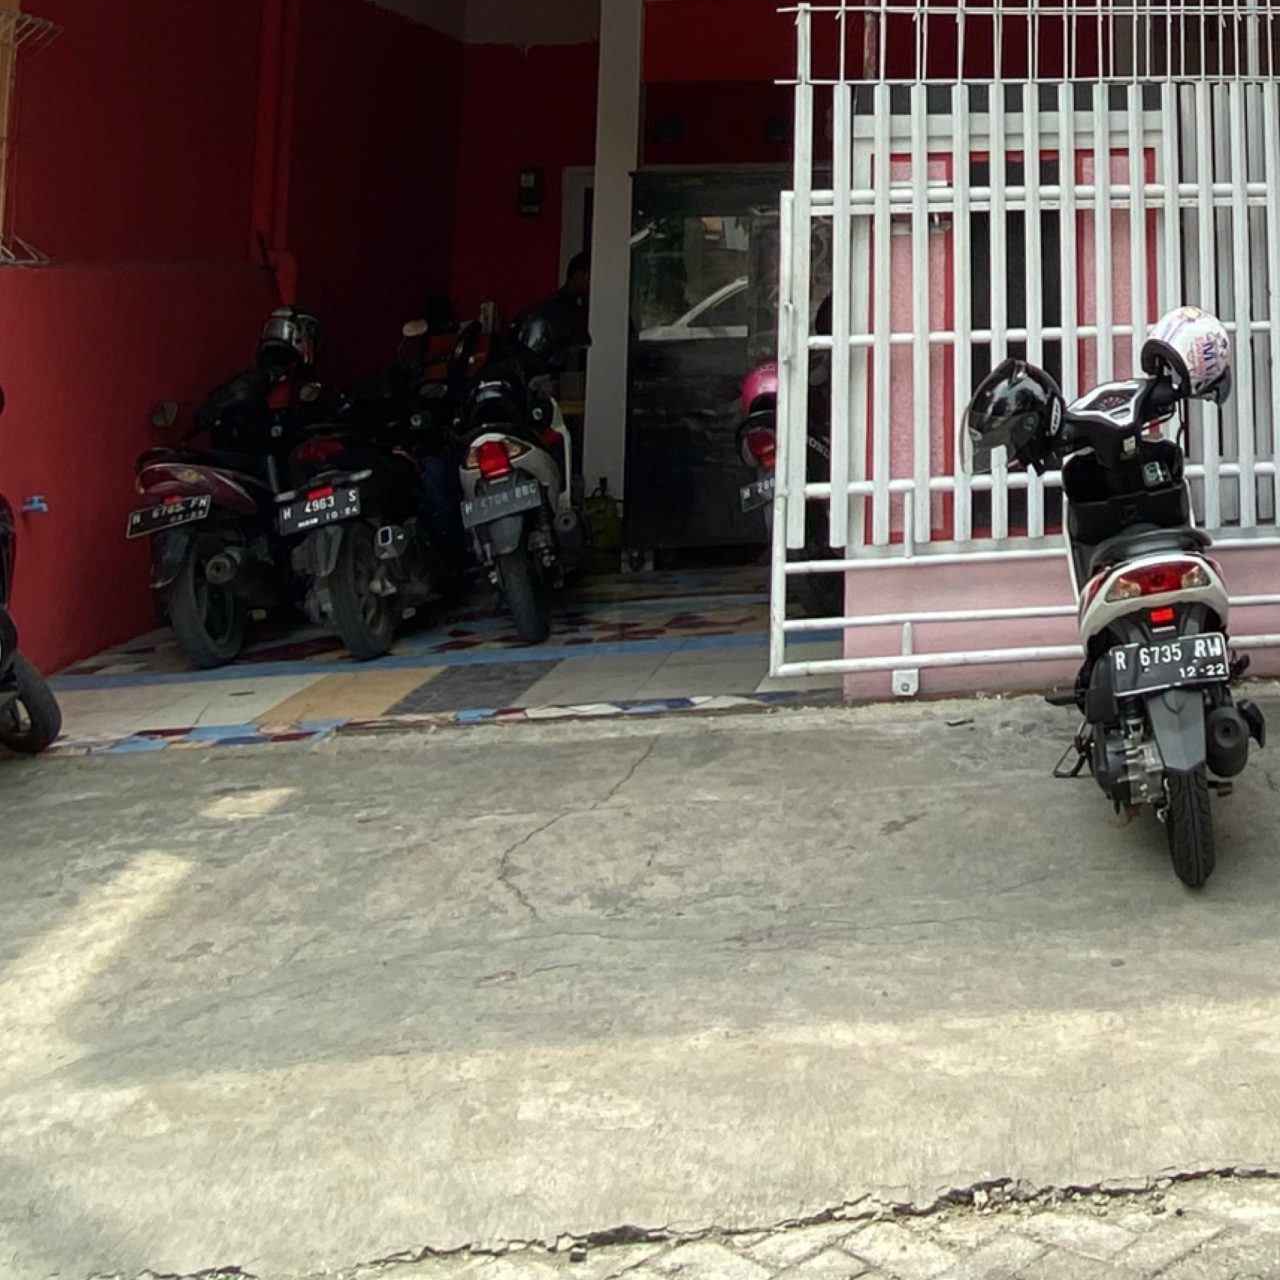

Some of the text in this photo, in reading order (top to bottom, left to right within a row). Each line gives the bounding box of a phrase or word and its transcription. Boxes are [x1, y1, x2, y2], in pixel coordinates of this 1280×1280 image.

[1114, 636, 1223, 671] R 6735 RW
